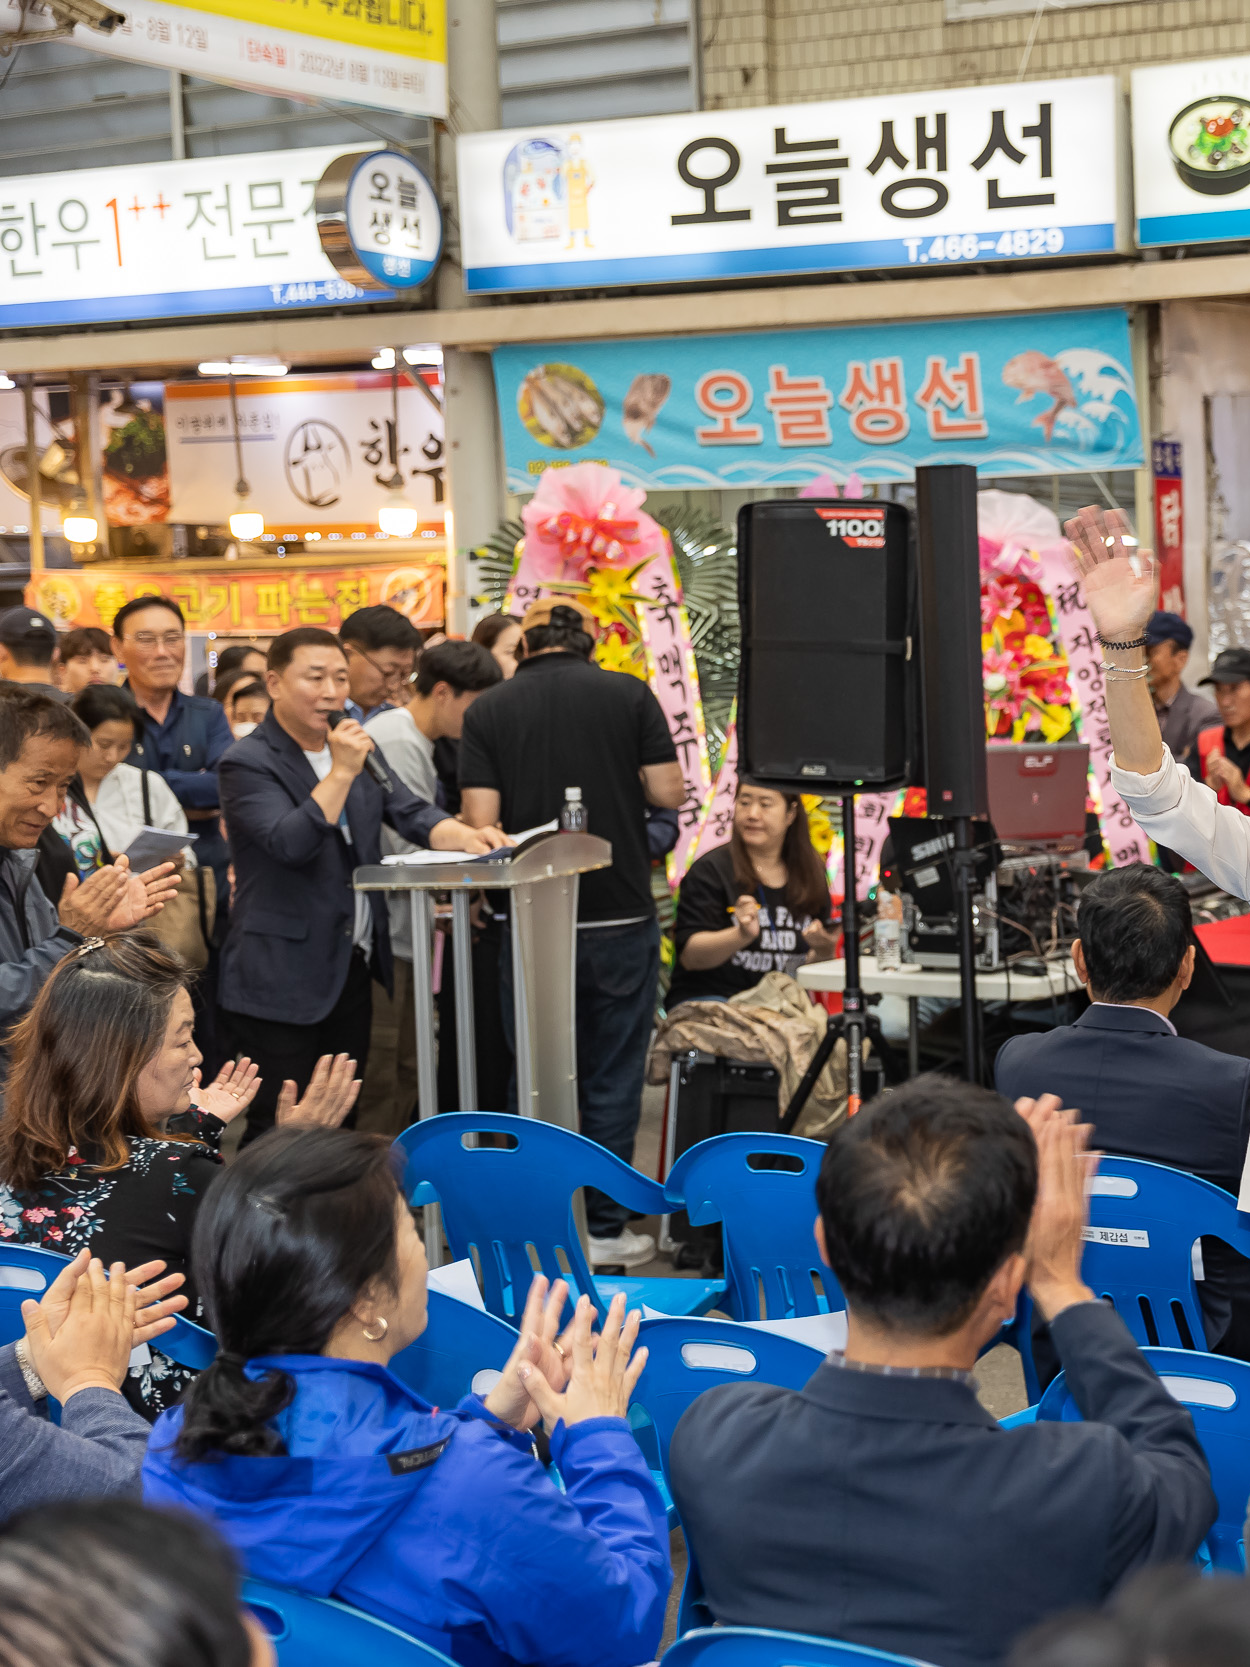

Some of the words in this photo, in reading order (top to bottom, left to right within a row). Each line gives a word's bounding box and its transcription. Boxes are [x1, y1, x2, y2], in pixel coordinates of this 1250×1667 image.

[670, 103, 1056, 227] 오늘생선
[369, 172, 418, 210] 오늘
[369, 212, 421, 250] 생선
[904, 228, 1064, 263] T.466-4829
[695, 351, 990, 448] 오늘생선
[826, 518, 881, 537] 1100
[95, 579, 241, 630] 좋고기
[1099, 1231, 1129, 1243] 제갑섭
